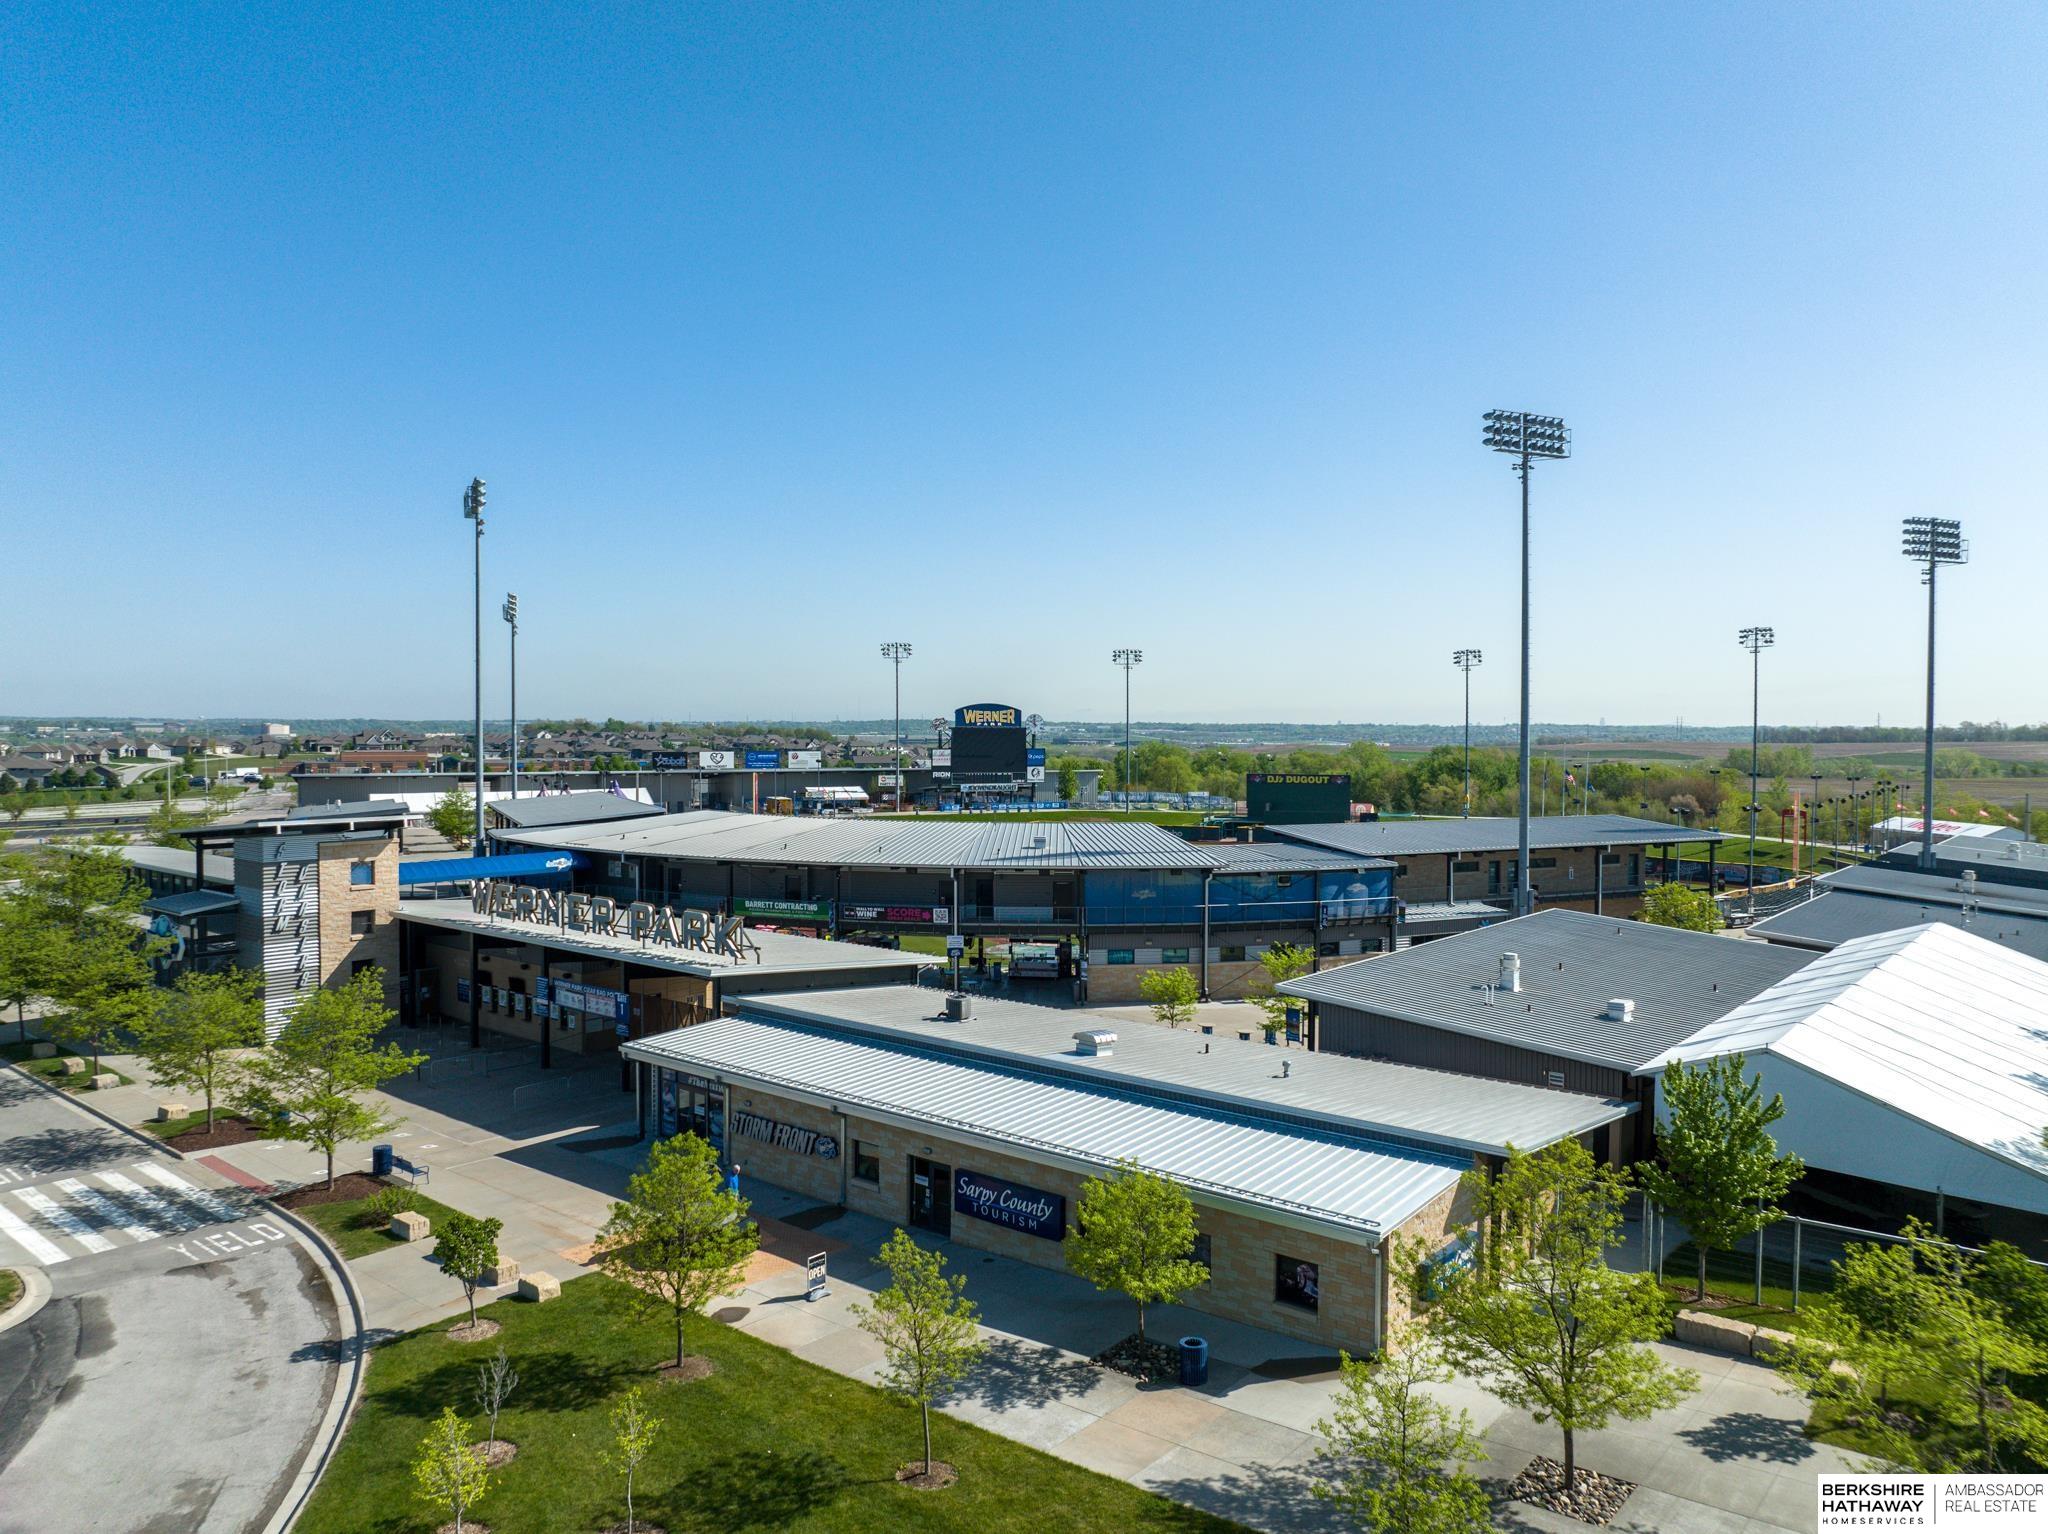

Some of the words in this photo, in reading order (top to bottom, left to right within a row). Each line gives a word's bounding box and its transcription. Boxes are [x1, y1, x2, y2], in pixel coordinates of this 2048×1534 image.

[963, 708, 1015, 724] WERNER
[1286, 775, 1329, 784] DUGOUT
[276, 842, 291, 932] STORM
[745, 900, 773, 909] BARRETT
[774, 902, 818, 911] CONTRACTING
[886, 908, 921, 917] SCORE
[469, 879, 617, 937] WERNER
[630, 901, 746, 960] PARK
[620, 1004, 624, 1015] 1
[730, 1112, 774, 1144] STORM
[774, 1123, 817, 1156] FRONT
[958, 1177, 998, 1205] Sarpy
[1000, 1189, 1053, 1222] County
[972, 1202, 1037, 1230] TOURISM
[167, 1223, 286, 1261] YIELD
[808, 1265, 825, 1280] OPEN
